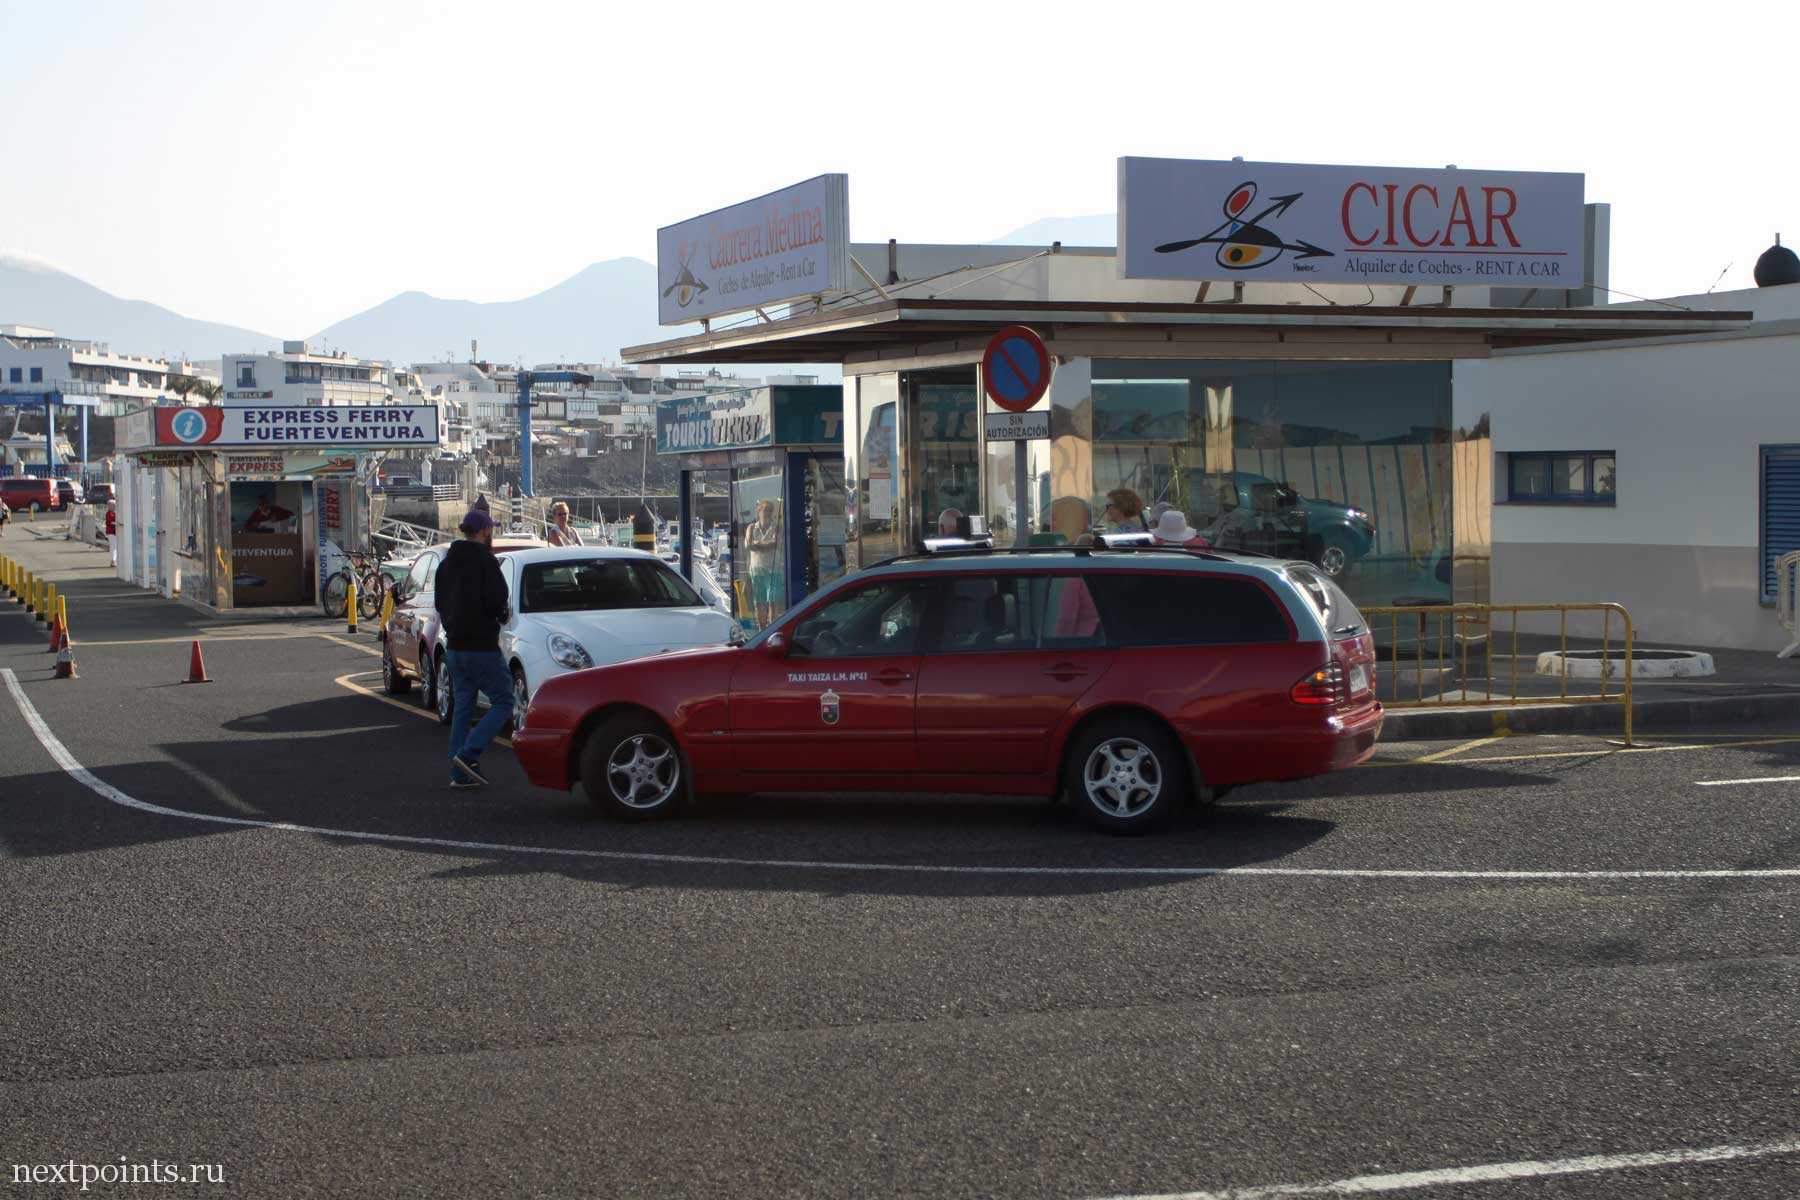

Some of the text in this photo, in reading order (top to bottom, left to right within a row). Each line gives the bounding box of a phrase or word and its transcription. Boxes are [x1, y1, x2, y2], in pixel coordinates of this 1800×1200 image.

[1341, 182, 1521, 248] CICAR
[1344, 258, 1396, 277] Alquiler
[1400, 260, 1414, 275] de
[1418, 259, 1463, 275] Coches
[1475, 261, 1514, 276] RENT
[1516, 262, 1528, 275] A
[1530, 262, 1560, 276] CAR
[244, 410, 414, 424] EXPRESS FERRY
[1009, 415, 1024, 426] SIN
[244, 426, 424, 440] FUERTEVENTURA
[666, 418, 715, 448] TOURIST
[986, 425, 1048, 439] AUTORIZACIÓN
[229, 463, 284, 472] EXPRESS
[326, 487, 340, 529] FERRY
[788, 673, 807, 682] TAXI
[808, 673, 831, 681] YAIZA
